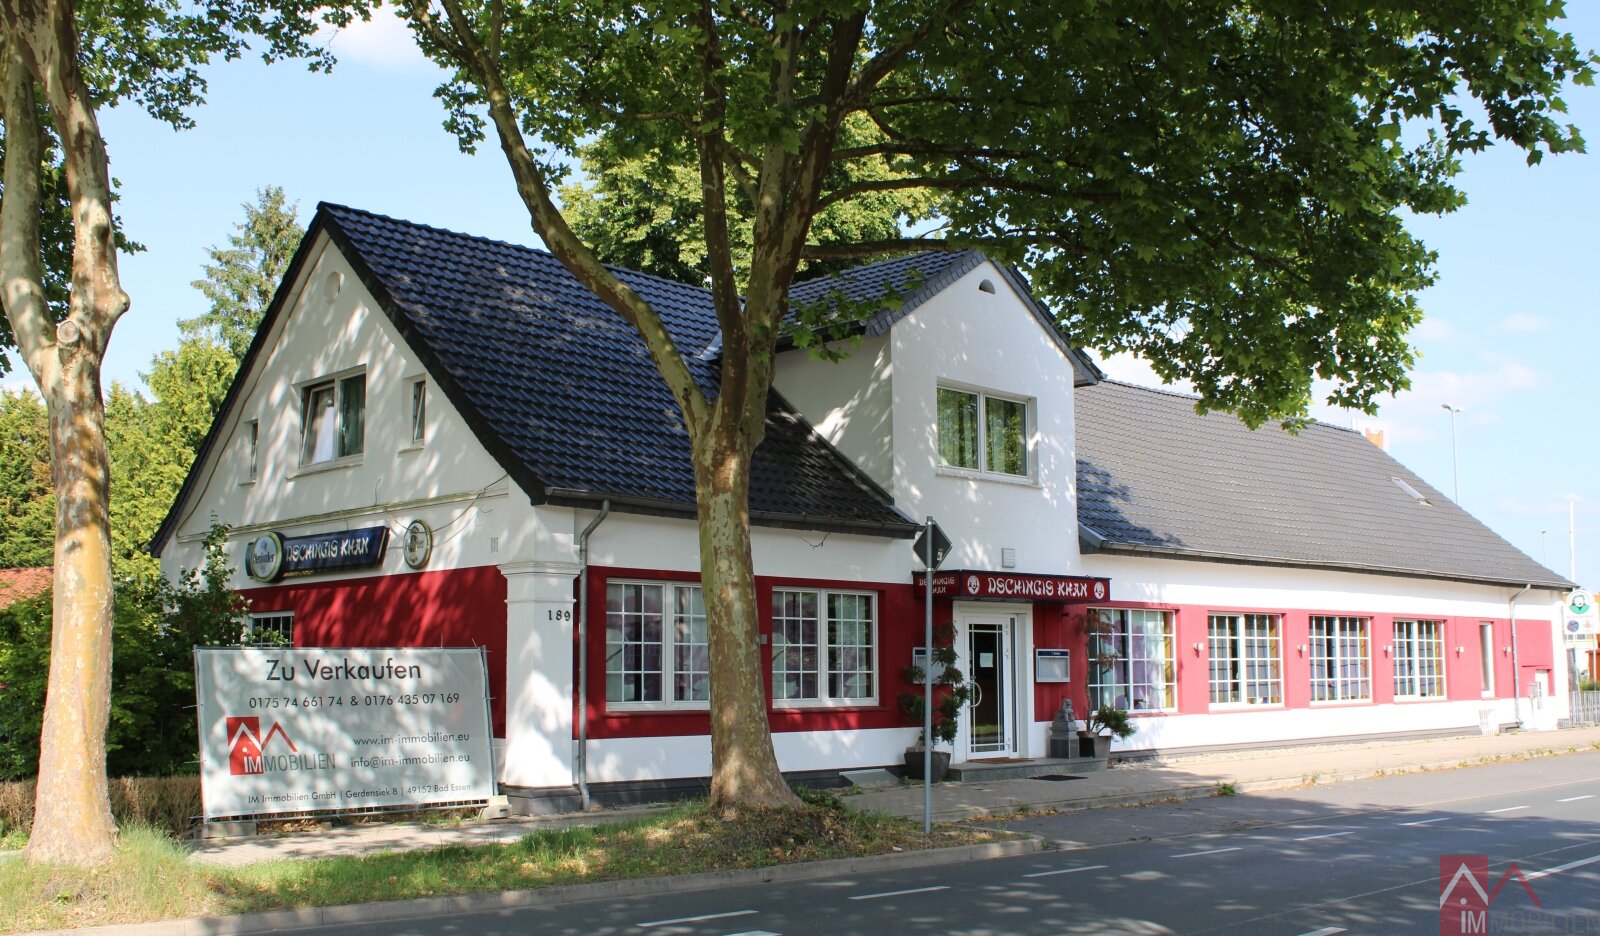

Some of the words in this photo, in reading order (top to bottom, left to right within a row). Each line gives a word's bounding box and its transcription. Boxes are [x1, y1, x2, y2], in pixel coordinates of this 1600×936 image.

[285, 539, 339, 562] DSCHINGIS
[340, 536, 369, 556] KHAN
[919, 577, 955, 586] DSHINGIS
[987, 577, 1054, 596] DSCHINGIS
[1057, 581, 1088, 597] KHAN
[548, 609, 571, 622] 189
[266, 659, 295, 681] Zu
[303, 657, 422, 680] Verkaufen
[249, 697, 280, 709] 0175
[283, 697, 299, 708] 74
[302, 696, 323, 707] 661
[328, 696, 343, 707] 74
[350, 695, 359, 706] &
[364, 695, 394, 706] 0176
[397, 694, 420, 705] 435
[422, 693, 437, 704] 07
[440, 692, 460, 704] 169
[353, 731, 471, 746] www.im-immobilien.eu
[243, 752, 336, 773] IMMOBILIEN
[350, 752, 471, 769] info@im-immobilien.eu
[248, 795, 260, 804] IM
[262, 791, 309, 803] Immobilien
[311, 791, 336, 800] GmbH
[345, 788, 391, 799] Gerdensiek
[392, 787, 398, 796] 8
[407, 785, 432, 795] 49152
[434, 783, 449, 793] Bad
[450, 782, 471, 792] Essen
